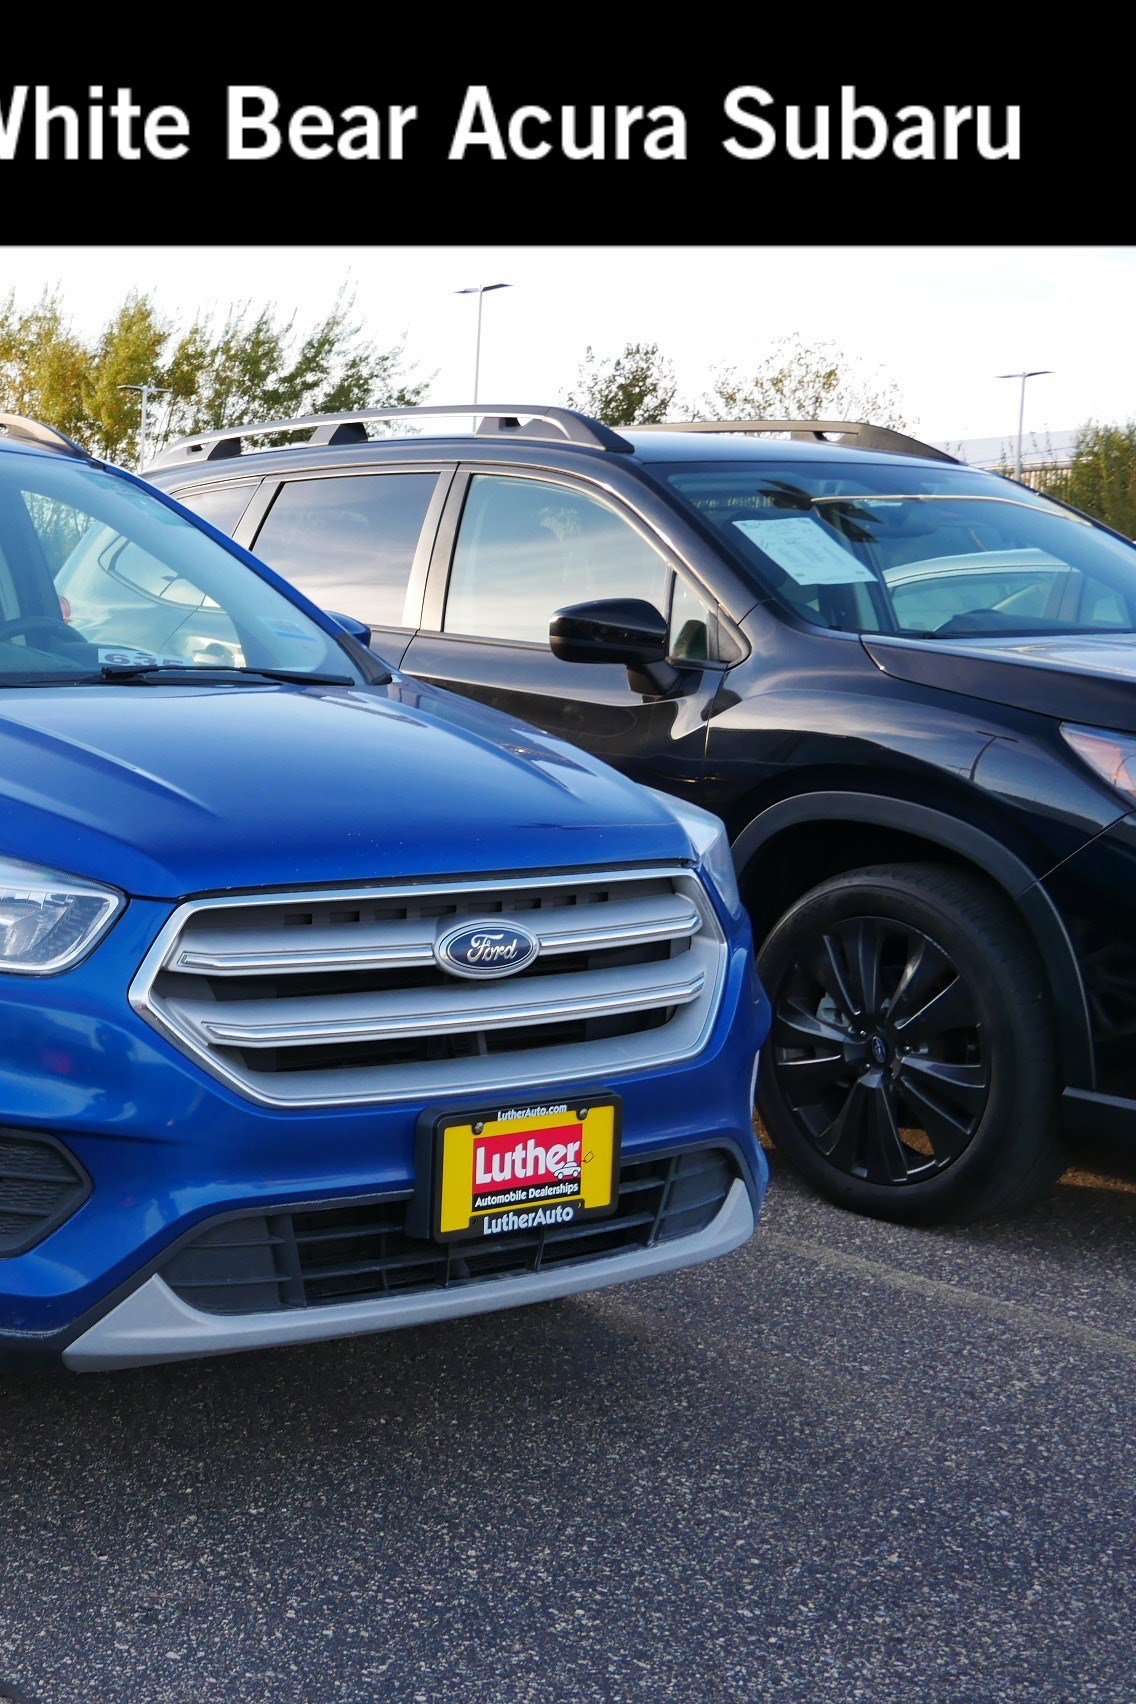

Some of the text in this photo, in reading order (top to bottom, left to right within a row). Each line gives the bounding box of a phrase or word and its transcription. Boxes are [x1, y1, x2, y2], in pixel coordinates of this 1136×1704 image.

[466, 933, 518, 963] Ford
[497, 1104, 568, 1122] LutherAuto.com
[475, 1138, 582, 1185] Luther
[474, 1182, 579, 1208] Automobile Dealerships
[483, 1204, 574, 1235] LutherAuto
